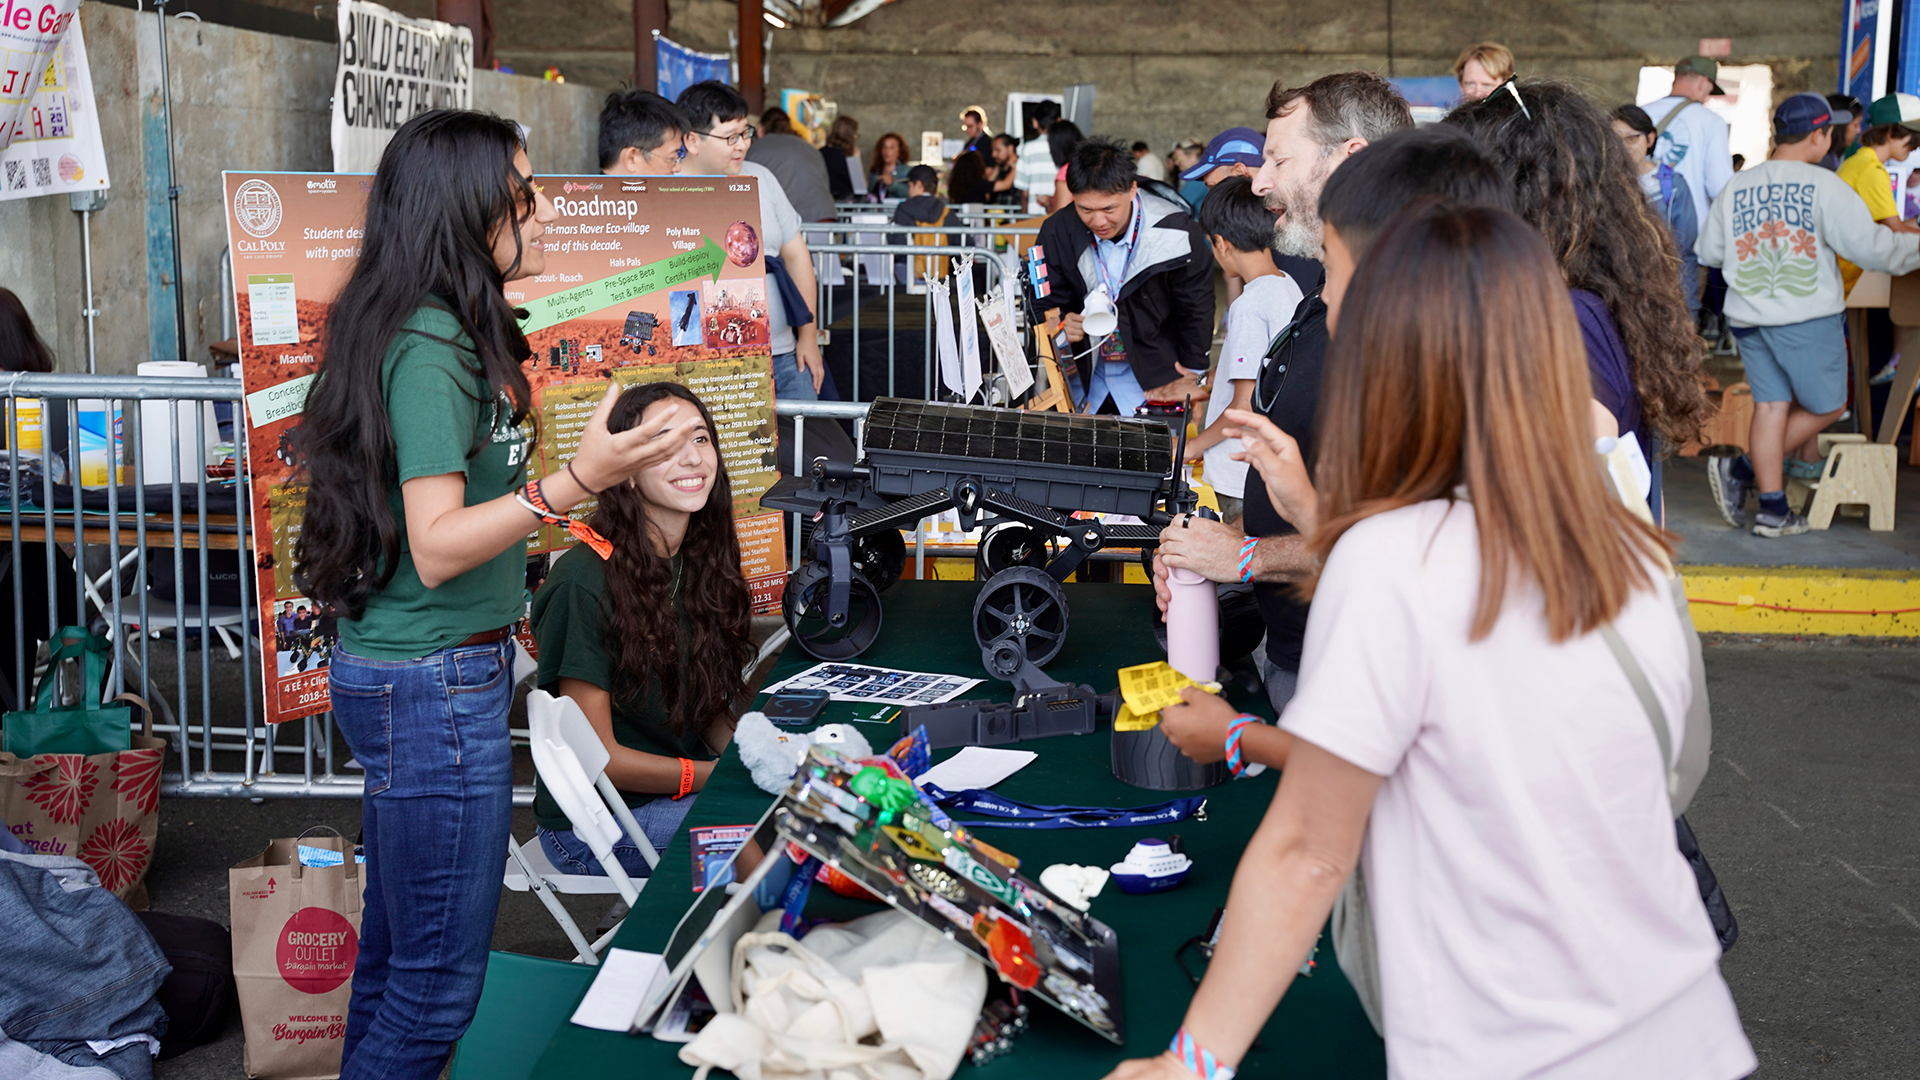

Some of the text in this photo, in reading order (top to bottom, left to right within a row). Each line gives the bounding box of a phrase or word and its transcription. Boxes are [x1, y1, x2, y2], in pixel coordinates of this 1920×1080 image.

[0, 0, 31, 30] le
[343, 11, 392, 71] BUILD
[343, 71, 403, 130] CHANGE
[553, 194, 638, 220] Roadmap
[1741, 204, 1815, 234] ROADS
[303, 227, 344, 240] Student
[580, 223, 604, 235] Rover
[606, 222, 650, 236] Eco-village
[666, 226, 700, 238] Poly Mars
[238, 240, 286, 252] CAL POLY
[561, 240, 572, 254] of
[572, 239, 589, 252] this
[590, 238, 624, 251] decade.
[672, 239, 696, 251] Village
[305, 246, 354, 260] with goal
[610, 256, 642, 268] Hals Pals
[668, 250, 710, 270] Build-deploy
[560, 272, 584, 282] Roach
[604, 267, 656, 290] Pre-Space Beta
[664, 260, 720, 286] Certify Flight Rdy
[546, 286, 594, 308] Multi-Agents
[610, 282, 655, 302] Test & Refine
[556, 304, 586, 320] Ai Servo
[280, 353, 314, 365] Marvin
[688, 377, 709, 385] Starship
[710, 375, 733, 383] transport
[746, 381, 758, 389] 2029
[268, 382, 306, 402] Concept
[713, 394, 724, 402] Poly
[738, 392, 755, 400] Village
[555, 402, 576, 410] Robust
[728, 402, 746, 410] Rovers
[555, 412, 577, 420] mission
[734, 411, 748, 419] Mars
[556, 422, 574, 430] Invent
[754, 418, 768, 426] Earth
[556, 432, 571, 440] keep
[557, 442, 572, 450] Next
[735, 458, 762, 467] Computing
[764, 465, 776, 474] dept
[272, 486, 297, 497] Based
[745, 486, 765, 494] services
[747, 520, 767, 528] Campus
[768, 516, 779, 524] DSN
[753, 526, 779, 536] Mechanics
[760, 537, 772, 545] base
[751, 546, 770, 556] Starlink
[750, 565, 771, 574] 2026-29
[763, 580, 770, 588] 20
[771, 578, 784, 586] MFG
[284, 684, 290, 693] 4
[292, 680, 302, 692] EE
[288, 931, 348, 946] GROCERY
[295, 946, 338, 962] OUTLET
[284, 958, 348, 974] bargain market
[272, 1022, 327, 1045] Bargain
